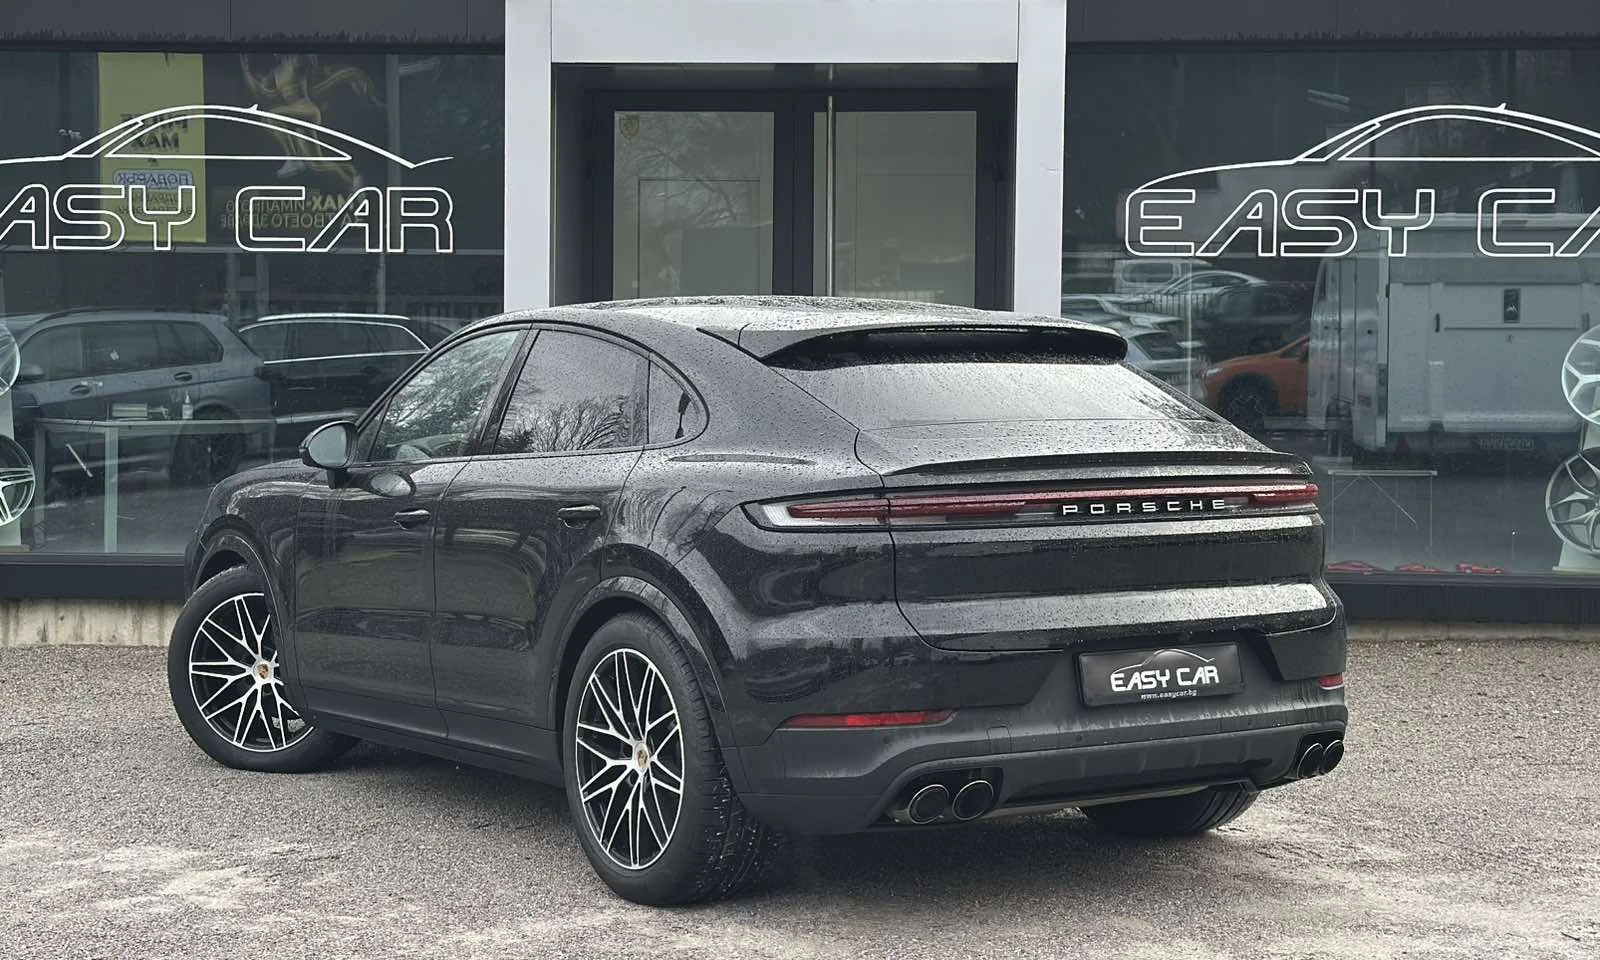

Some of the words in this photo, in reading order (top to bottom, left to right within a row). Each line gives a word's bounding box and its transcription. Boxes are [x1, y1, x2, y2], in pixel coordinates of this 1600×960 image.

[235, 185, 454, 253] CAR
[1125, 188, 1436, 257] EASY
[1062, 499, 1225, 516] PORSCHE
[1110, 669, 1171, 692] EASY
[1176, 665, 1220, 686] CAR
[1140, 688, 1198, 700] www.easycar.bg
